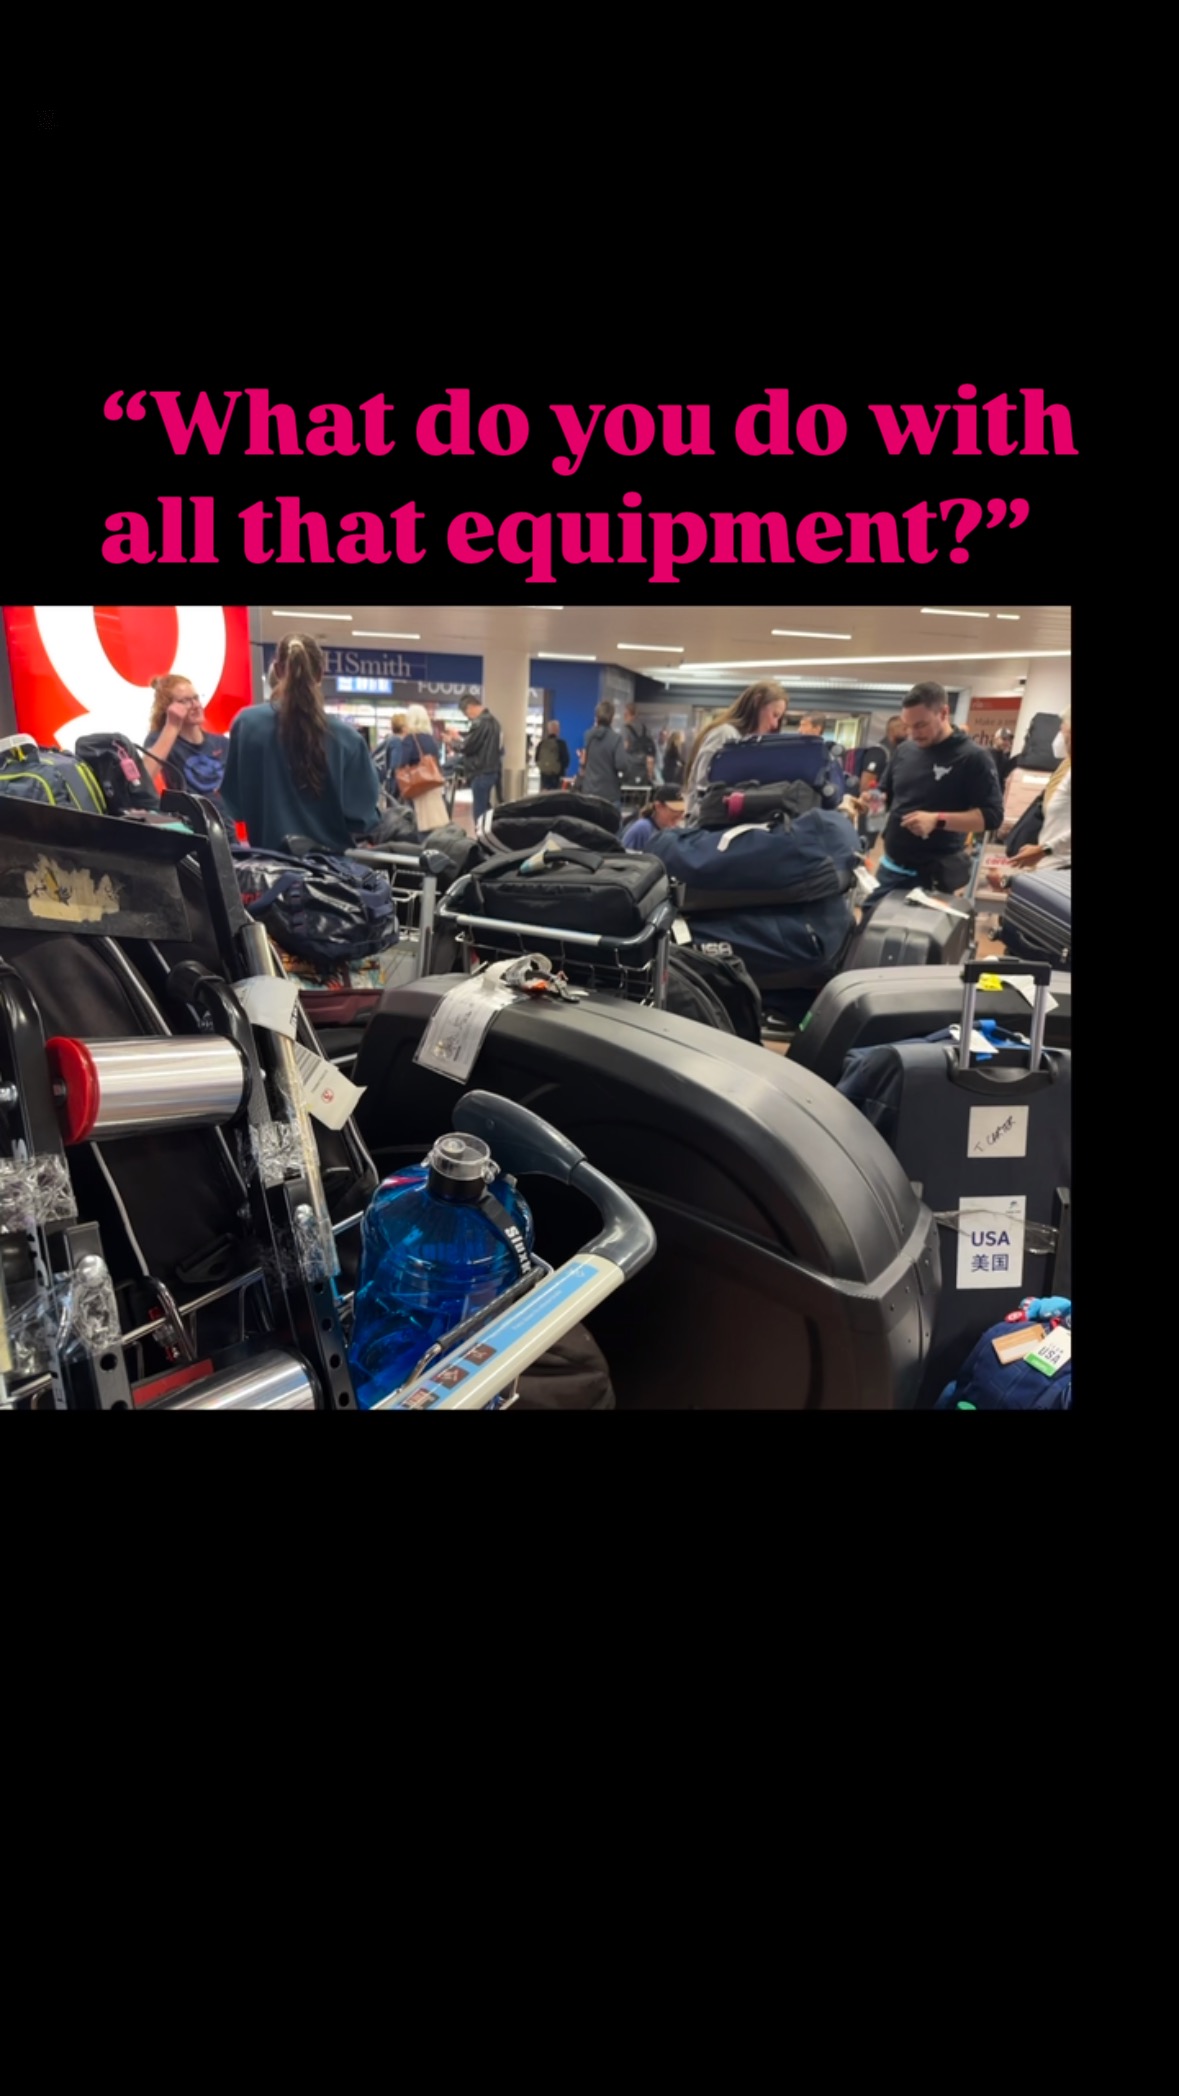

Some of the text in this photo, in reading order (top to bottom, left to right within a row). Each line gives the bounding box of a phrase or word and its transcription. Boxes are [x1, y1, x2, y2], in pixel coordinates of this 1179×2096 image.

[324, 651, 411, 677] HSmith
[418, 681, 465, 695] FOOD
[971, 1230, 1011, 1247] USA
[970, 1254, 1010, 1273] 美国
[1037, 1345, 1061, 1365] USA
